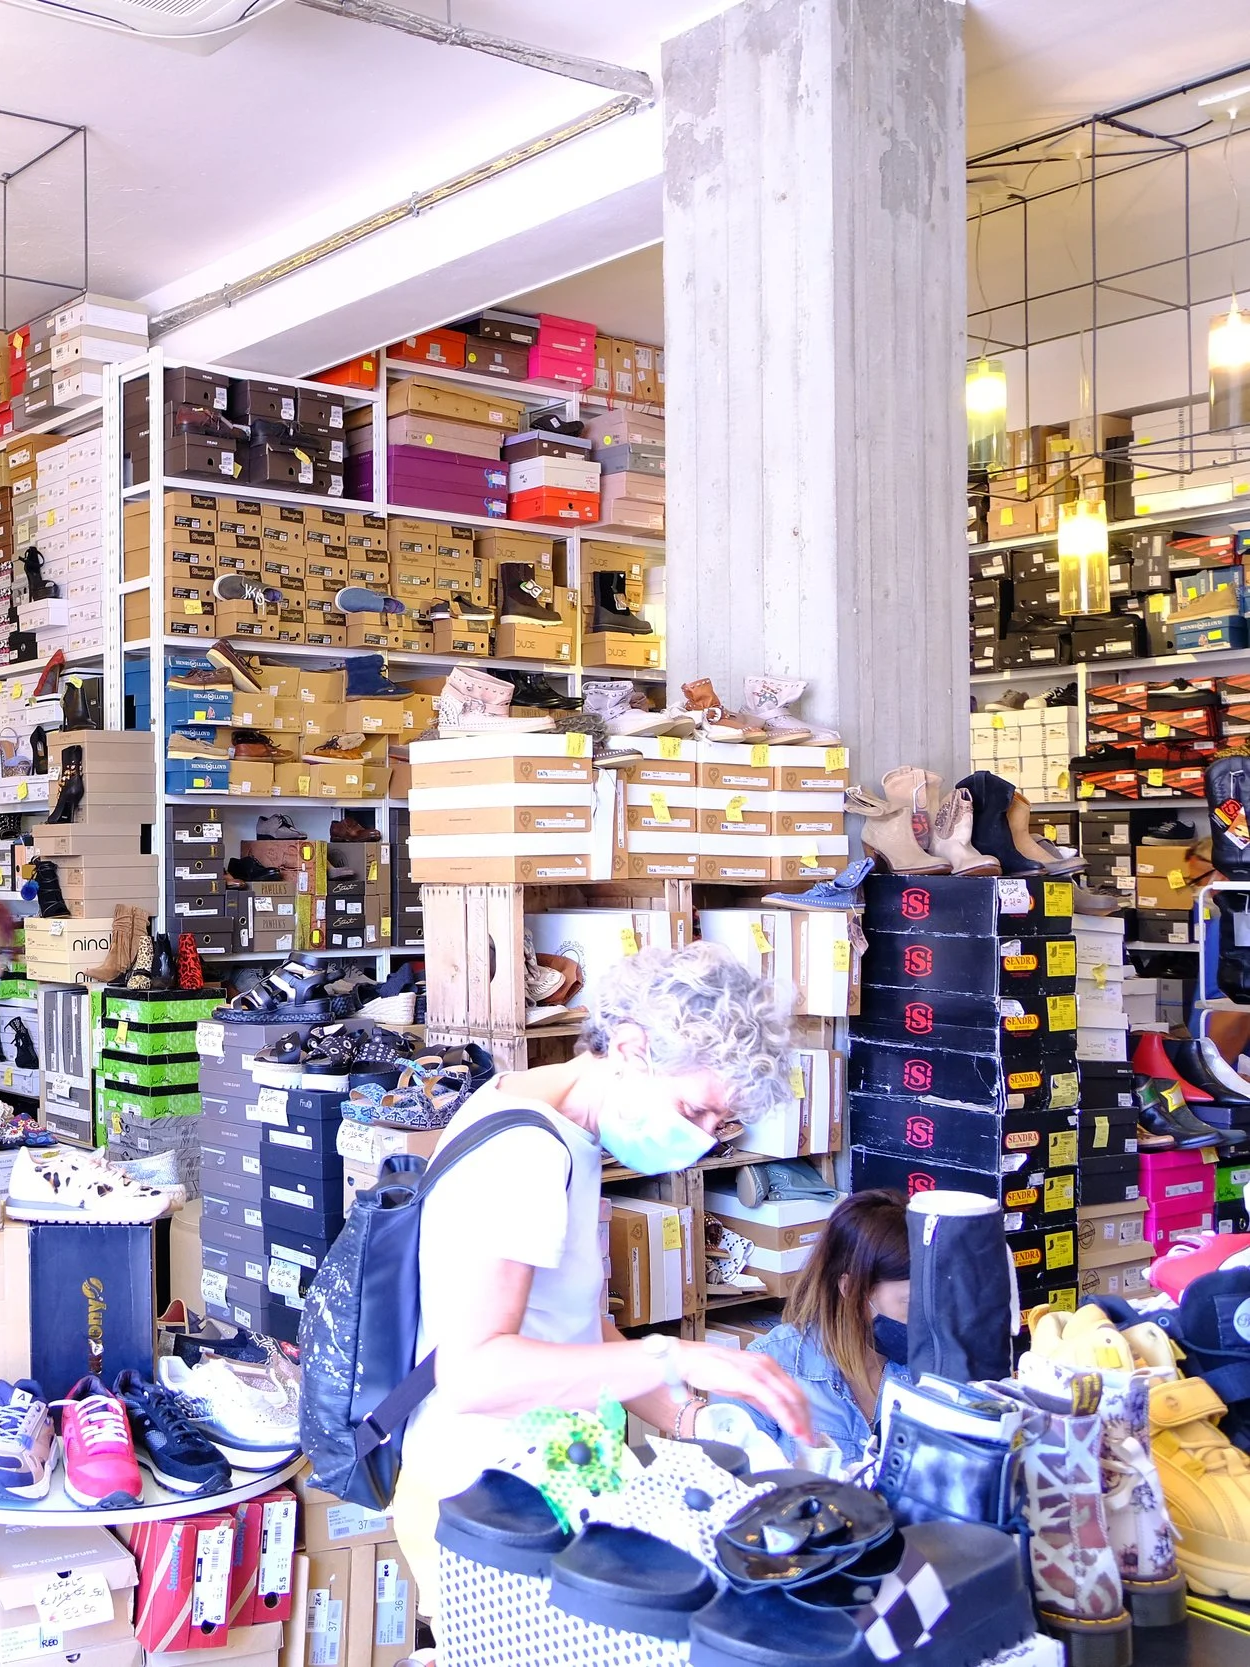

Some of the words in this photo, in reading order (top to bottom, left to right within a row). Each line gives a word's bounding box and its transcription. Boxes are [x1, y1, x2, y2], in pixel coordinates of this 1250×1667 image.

[1006, 955, 1036, 966] SENDRA
[1006, 1016, 1038, 1027] SENDRA
[1009, 1073, 1041, 1084] SENDRA
[1007, 1132, 1039, 1142] SENDRA
[1007, 1189, 1038, 1200] SENDRA
[358, 1519, 368, 1530] 37
[38, 1556, 63, 1565] YOUR
[64, 1549, 99, 1561] FUTURE
[279, 1576, 287, 1591] 5.5
[395, 1600, 404, 1611] 36
[328, 1621, 337, 1632] 37
